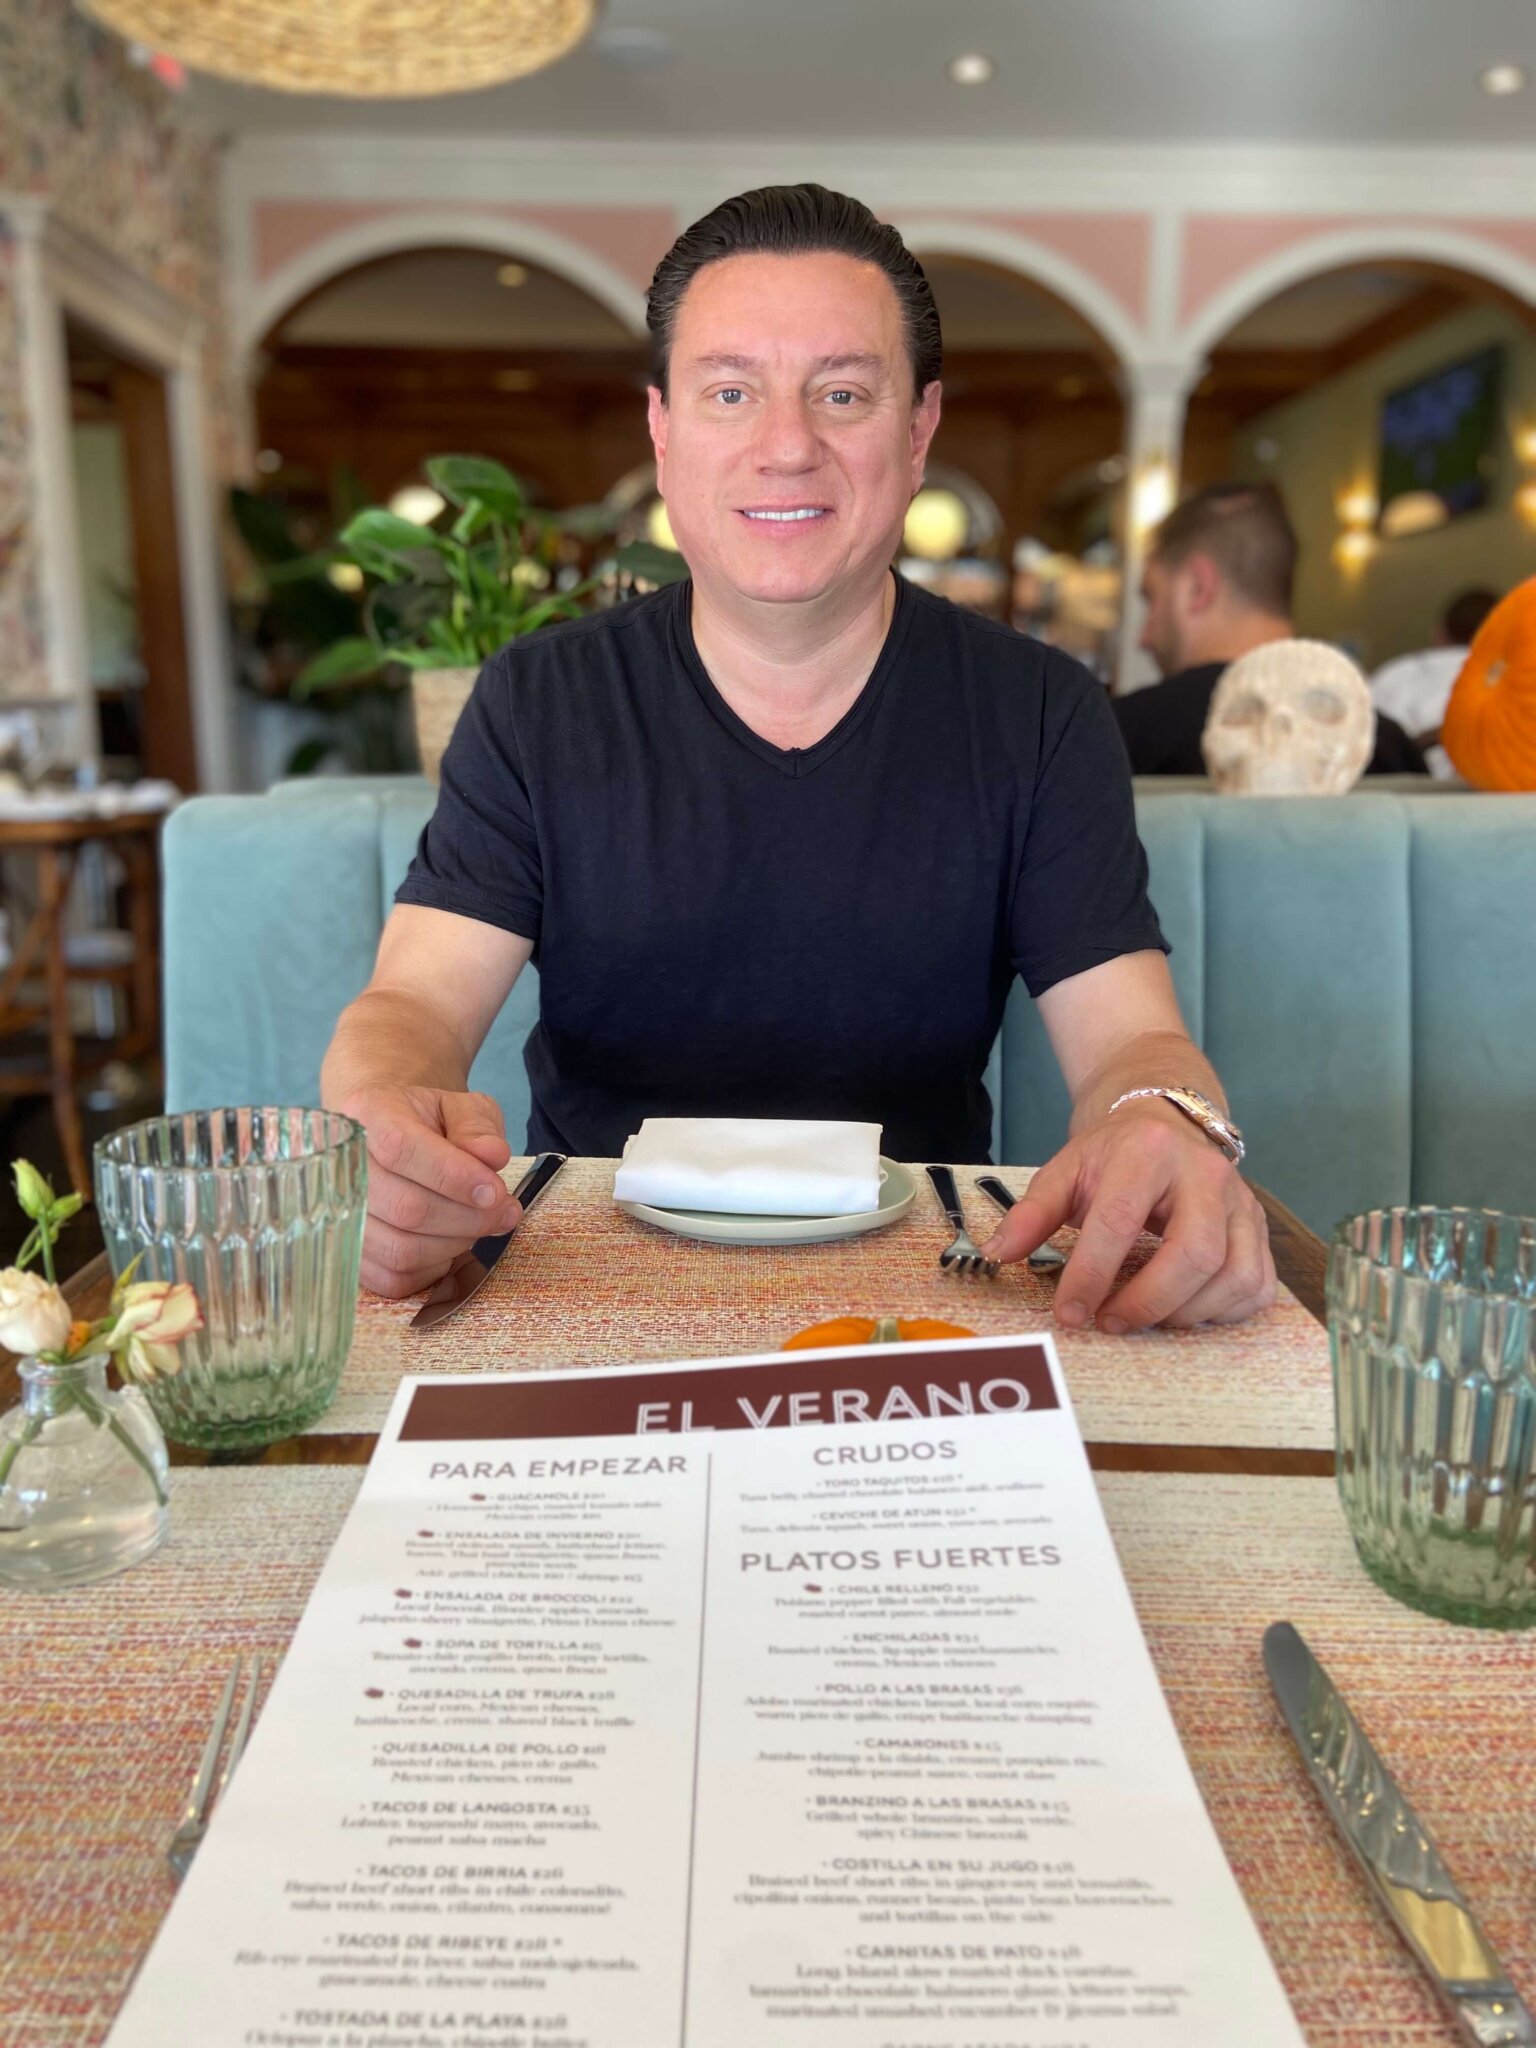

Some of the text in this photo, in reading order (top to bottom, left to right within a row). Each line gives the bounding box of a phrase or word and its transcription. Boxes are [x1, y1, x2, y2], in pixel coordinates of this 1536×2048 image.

[636, 1378, 1031, 1434] EL VERANO
[813, 1441, 958, 1465] CRUDOS
[429, 1456, 688, 1479] PARA EMPEZAR
[824, 1478, 860, 1488] TORO
[497, 1492, 579, 1501] GUACAMOLE
[819, 1510, 878, 1521] CEVICHE
[882, 1509, 900, 1519] DE
[446, 1531, 520, 1542] ENSALADA
[524, 1531, 542, 1542] DE
[546, 1531, 615, 1540] INVIERNO
[740, 1546, 1062, 1572] PLATOS FUERTES
[838, 1585, 881, 1594] CHILE
[885, 1583, 954, 1596] RELLENO
[424, 1591, 504, 1601] ENSALADA
[508, 1592, 527, 1602] DE
[532, 1593, 606, 1604] BROCCOLI
[852, 1632, 951, 1643] ENCHILADAS
[436, 1639, 475, 1649] SOPA
[479, 1640, 500, 1650] DE
[506, 1640, 578, 1650] TORTILLA
[824, 1683, 877, 1694] POLLO
[880, 1684, 891, 1693] A
[895, 1684, 925, 1694] LAS
[929, 1684, 993, 1695] BRASAS
[398, 1689, 501, 1703] QUESADILLA
[505, 1689, 526, 1699] DE
[533, 1689, 584, 1700] TRUFA
[381, 1742, 490, 1754] QUESADILLA
[495, 1742, 517, 1754] DE
[522, 1743, 579, 1755] POLLO
[863, 1738, 970, 1750] CAMARONES
[371, 1801, 428, 1814] TACOS
[433, 1801, 457, 1814] DE
[462, 1802, 557, 1814] LANGOSTA
[815, 1795, 909, 1808] BRANZINO
[912, 1797, 925, 1808] A
[928, 1797, 962, 1809] LAS
[966, 1797, 1037, 1810] BRASAS
[831, 1857, 922, 1872] COSTILLA
[927, 1859, 953, 1872] EN
[957, 1859, 983, 1873] SU
[988, 1860, 1040, 1873] JUGO
[368, 1864, 428, 1879] TACOS
[433, 1865, 458, 1880] DE
[464, 1866, 527, 1879] BIRRIA
[337, 1933, 400, 1949] TACOS
[405, 1934, 432, 1950] DE
[438, 1935, 508, 1951] RIBEYE
[856, 1944, 956, 1960] CARNITAS
[960, 1944, 987, 1960] DE
[992, 1944, 1044, 1960] PATO
[294, 2008, 389, 2027] TOSTADA
[395, 2011, 424, 2029] DE
[430, 2012, 457, 2029] LA
[462, 2012, 526, 2030] PLAYA
